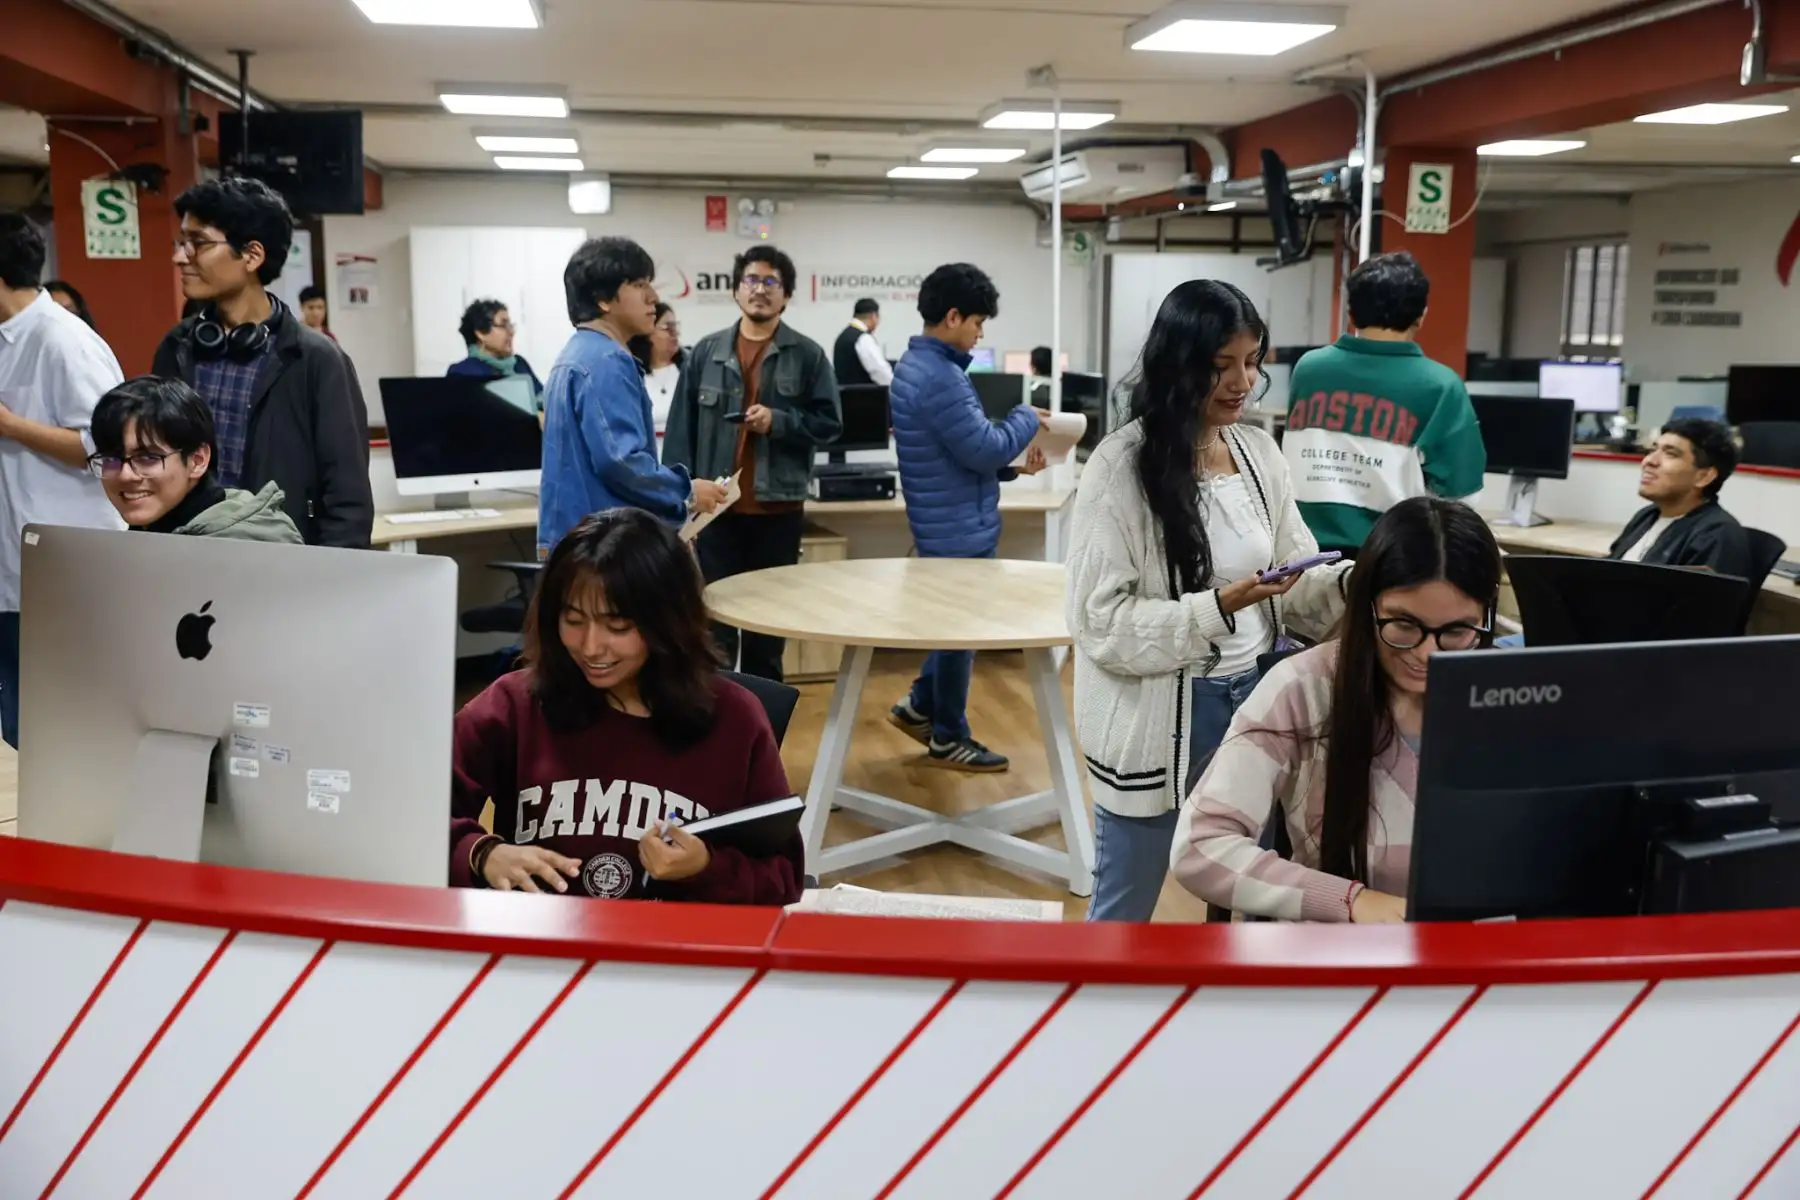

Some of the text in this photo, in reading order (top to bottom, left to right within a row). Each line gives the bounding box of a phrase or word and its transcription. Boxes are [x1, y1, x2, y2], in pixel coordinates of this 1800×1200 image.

[1418, 169, 1442, 203] S
[96, 188, 127, 225] S
[821, 272, 924, 289] INFORMACIÓ
[1301, 448, 1383, 468] COLLEGE TEAM
[1469, 684, 1562, 708] Lenovo
